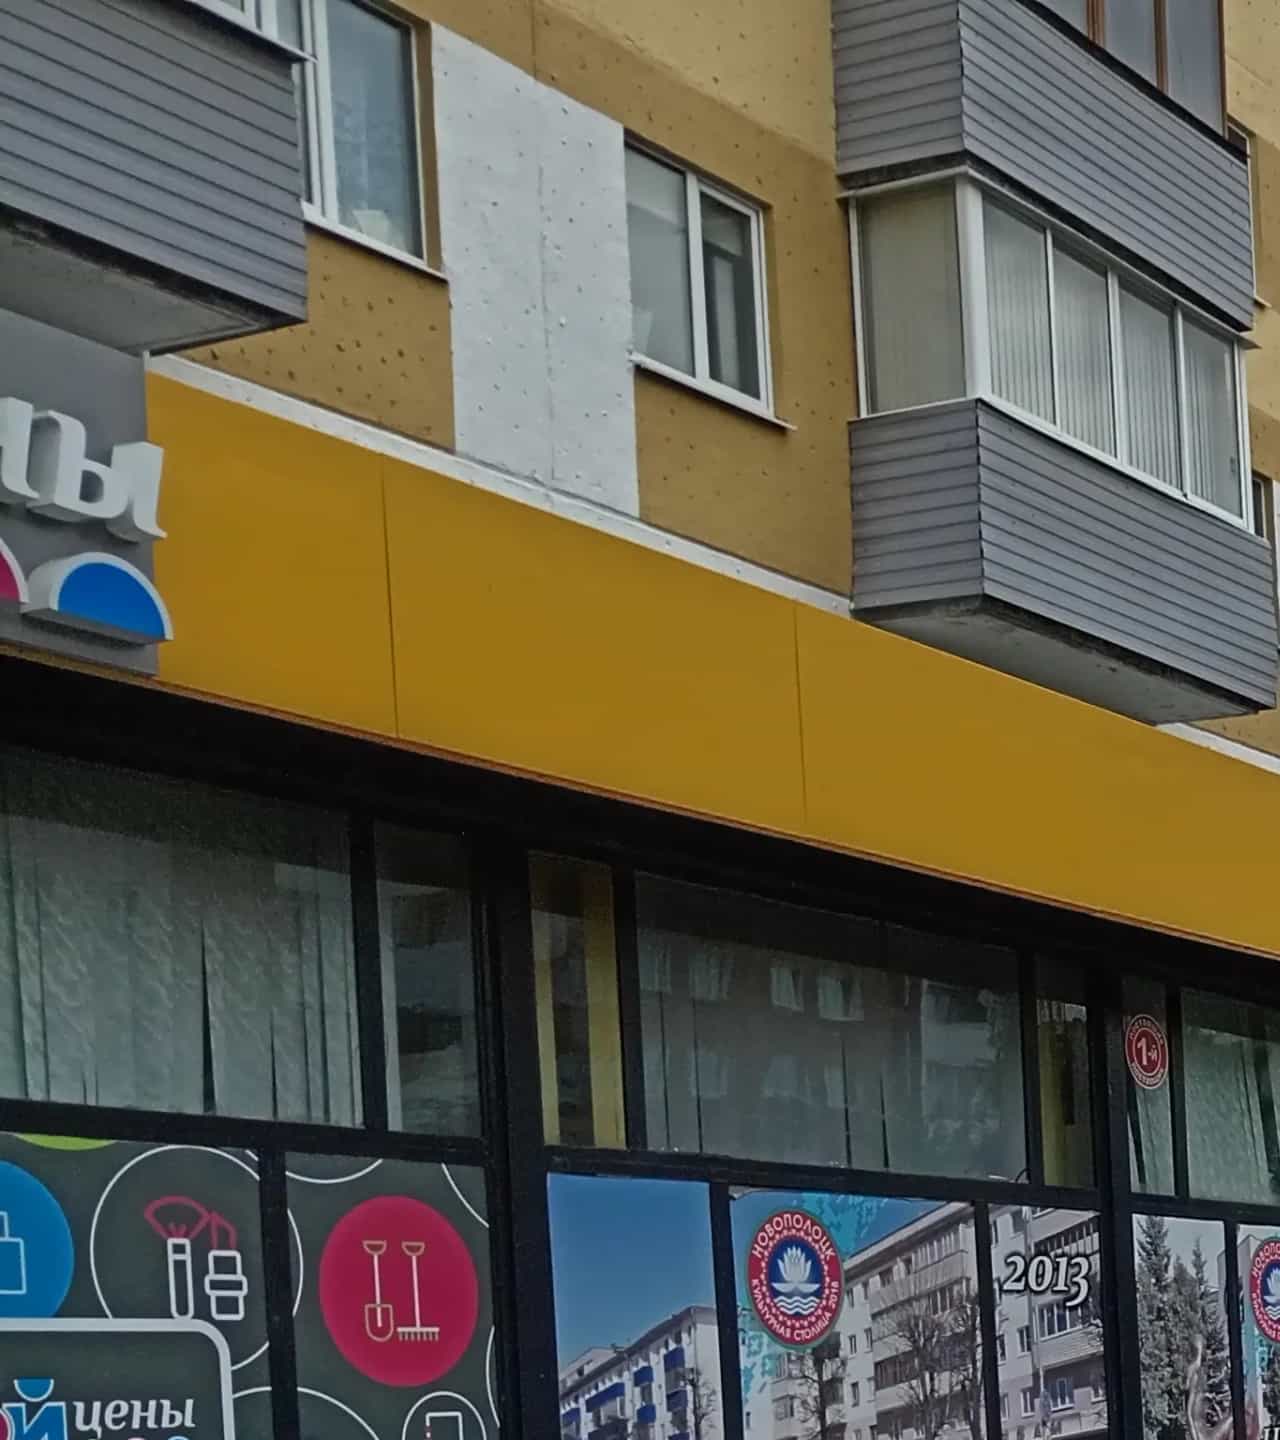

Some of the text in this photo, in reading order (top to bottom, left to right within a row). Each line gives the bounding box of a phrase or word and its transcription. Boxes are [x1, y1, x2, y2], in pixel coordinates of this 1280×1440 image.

[752, 1213, 836, 1260] НОВОПОЛОЦК
[1002, 1255, 1089, 1307] 2013
[73, 1399, 196, 1439] цены
